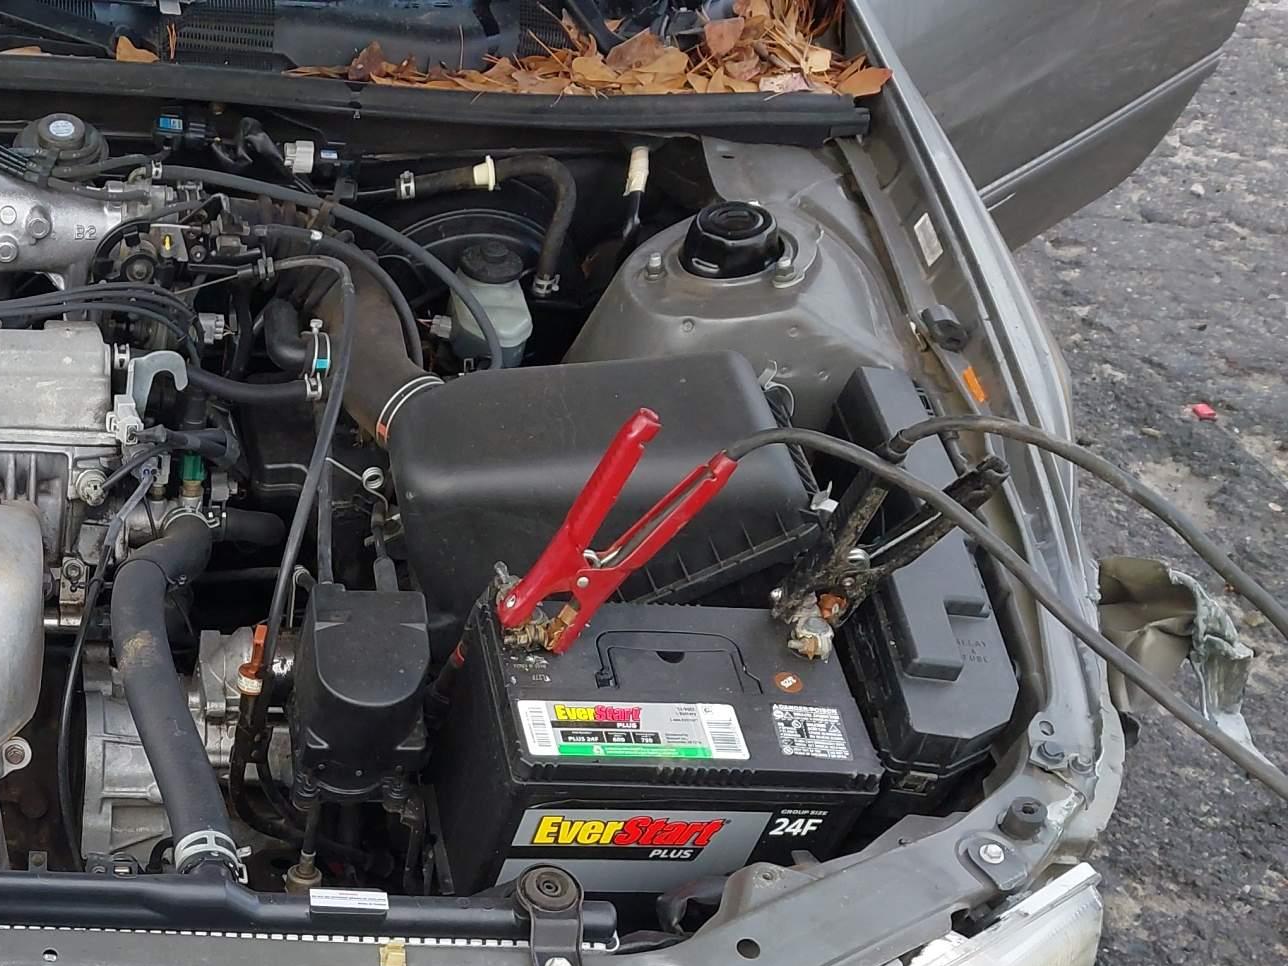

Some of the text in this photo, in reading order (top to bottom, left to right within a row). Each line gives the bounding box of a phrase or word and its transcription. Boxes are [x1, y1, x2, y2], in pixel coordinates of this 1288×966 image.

[74, 225, 97, 240] B2
[554, 704, 641, 721] EverStart
[533, 815, 725, 846] EverStart
[768, 818, 823, 836] 24F
[648, 848, 693, 860] PLUS
